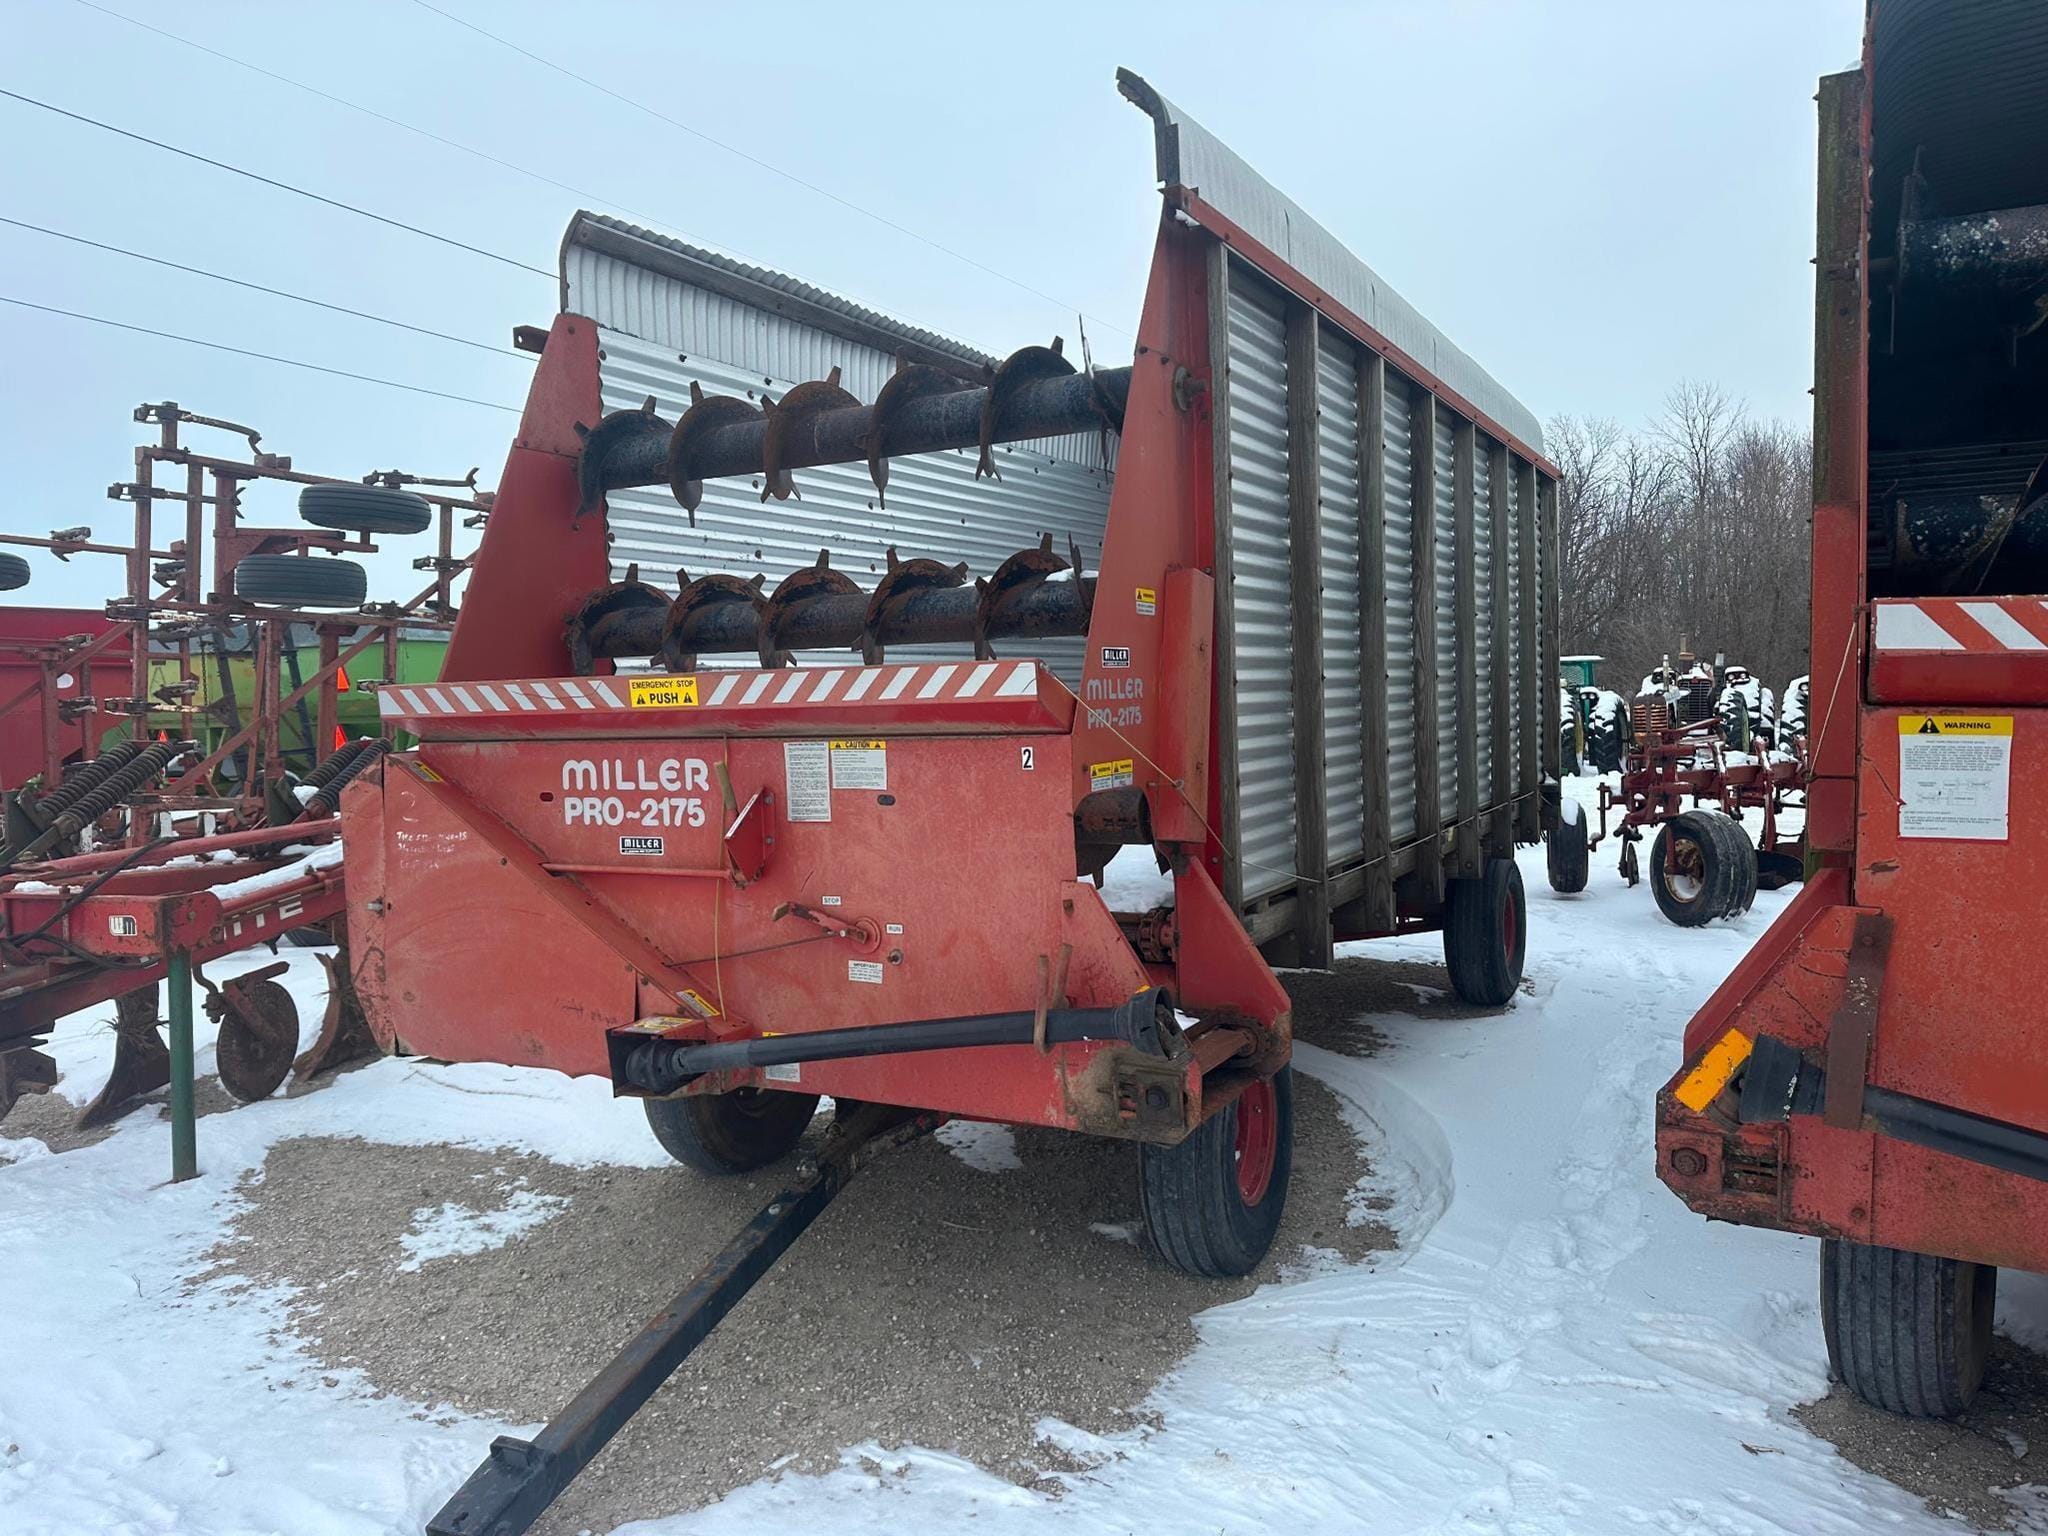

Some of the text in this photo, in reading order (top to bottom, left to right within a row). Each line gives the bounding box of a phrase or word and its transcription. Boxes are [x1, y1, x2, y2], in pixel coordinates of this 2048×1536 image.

[1104, 650, 1127, 660] MILLER
[632, 679, 694, 690] EMERGENCY STOP
[1087, 678, 1143, 700] MILLER
[649, 692, 679, 704] PUSH
[1943, 722, 1991, 730] WARNING
[845, 740, 871, 749] CAUTION
[1023, 748, 1032, 768] 2
[562, 758, 709, 791] MILLER
[624, 839, 660, 848] MILLER
